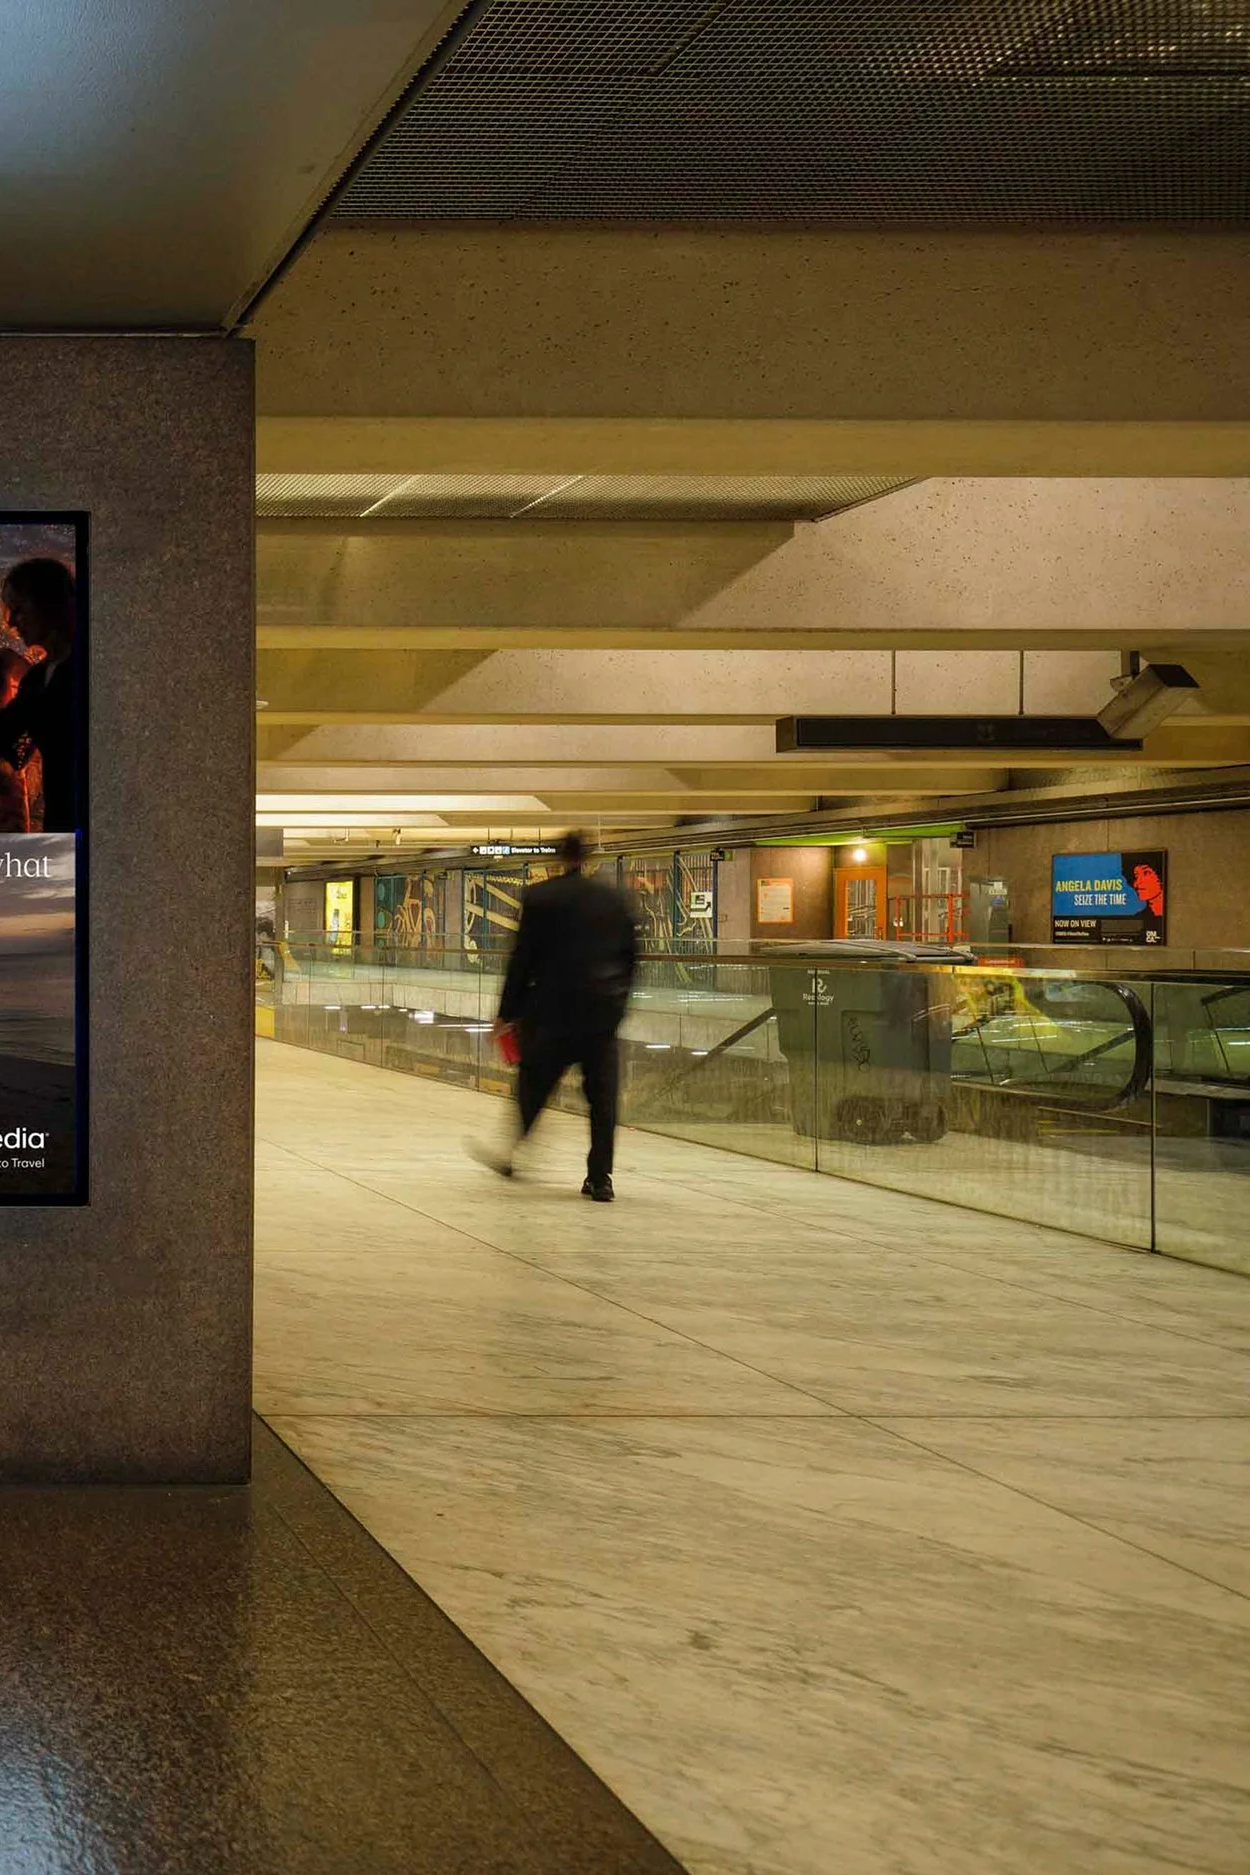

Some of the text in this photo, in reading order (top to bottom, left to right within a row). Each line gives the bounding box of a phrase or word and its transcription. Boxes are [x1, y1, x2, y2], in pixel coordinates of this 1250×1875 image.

[1055, 879, 1123, 892] ANGELA DAVIS
[1074, 893, 1127, 906] SEIZE THE TIME
[1054, 919, 1097, 928] NOW ON VIEW
[11, 1157, 46, 1168] Travel
